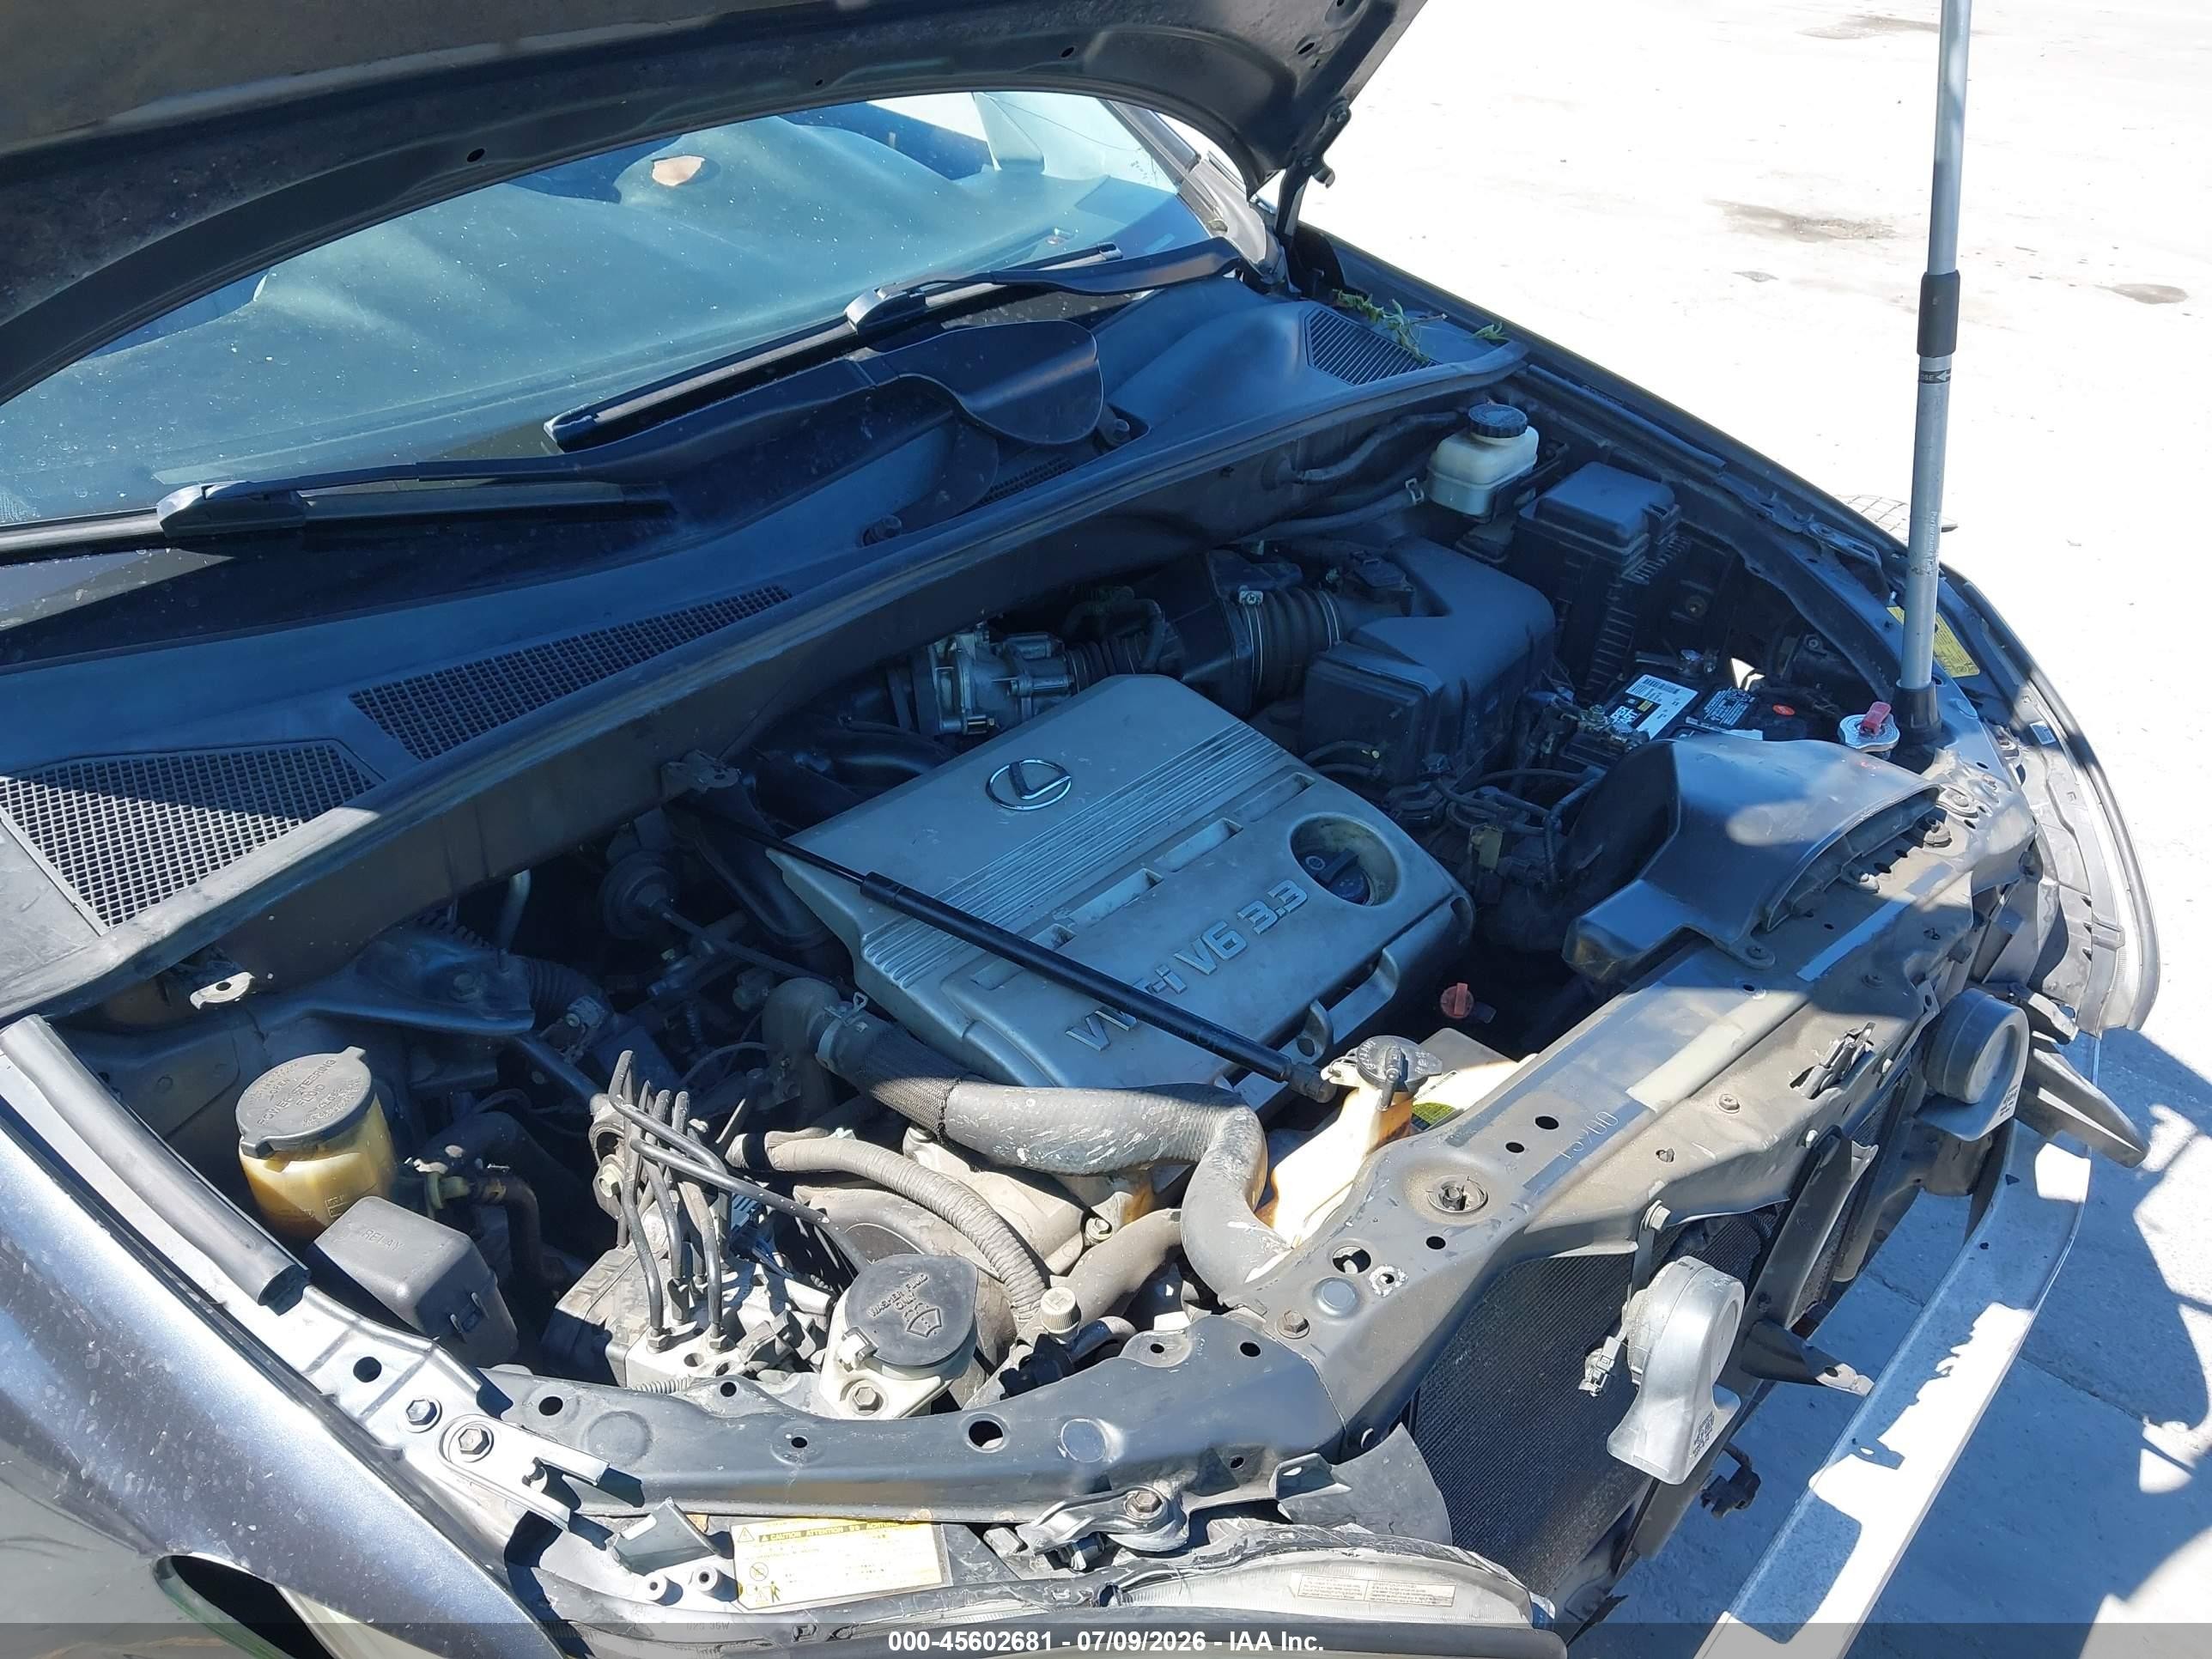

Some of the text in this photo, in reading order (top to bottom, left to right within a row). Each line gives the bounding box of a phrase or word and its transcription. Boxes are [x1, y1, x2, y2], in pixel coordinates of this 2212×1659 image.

[1174, 920, 1249, 975] V6
[1237, 878, 1309, 935] 3.3
[256, 1094, 294, 1127] POWER
[291, 1058, 337, 1097] STEERING
[295, 1083, 326, 1108] FLUID
[361, 1229, 405, 1251] RELAY
[866, 1273, 930, 1319] WASHER FLUID
[894, 1291, 916, 1311] ONLY
[769, 1530, 802, 1542] CAUTION
[805, 1526, 844, 1538] ATTENTION
